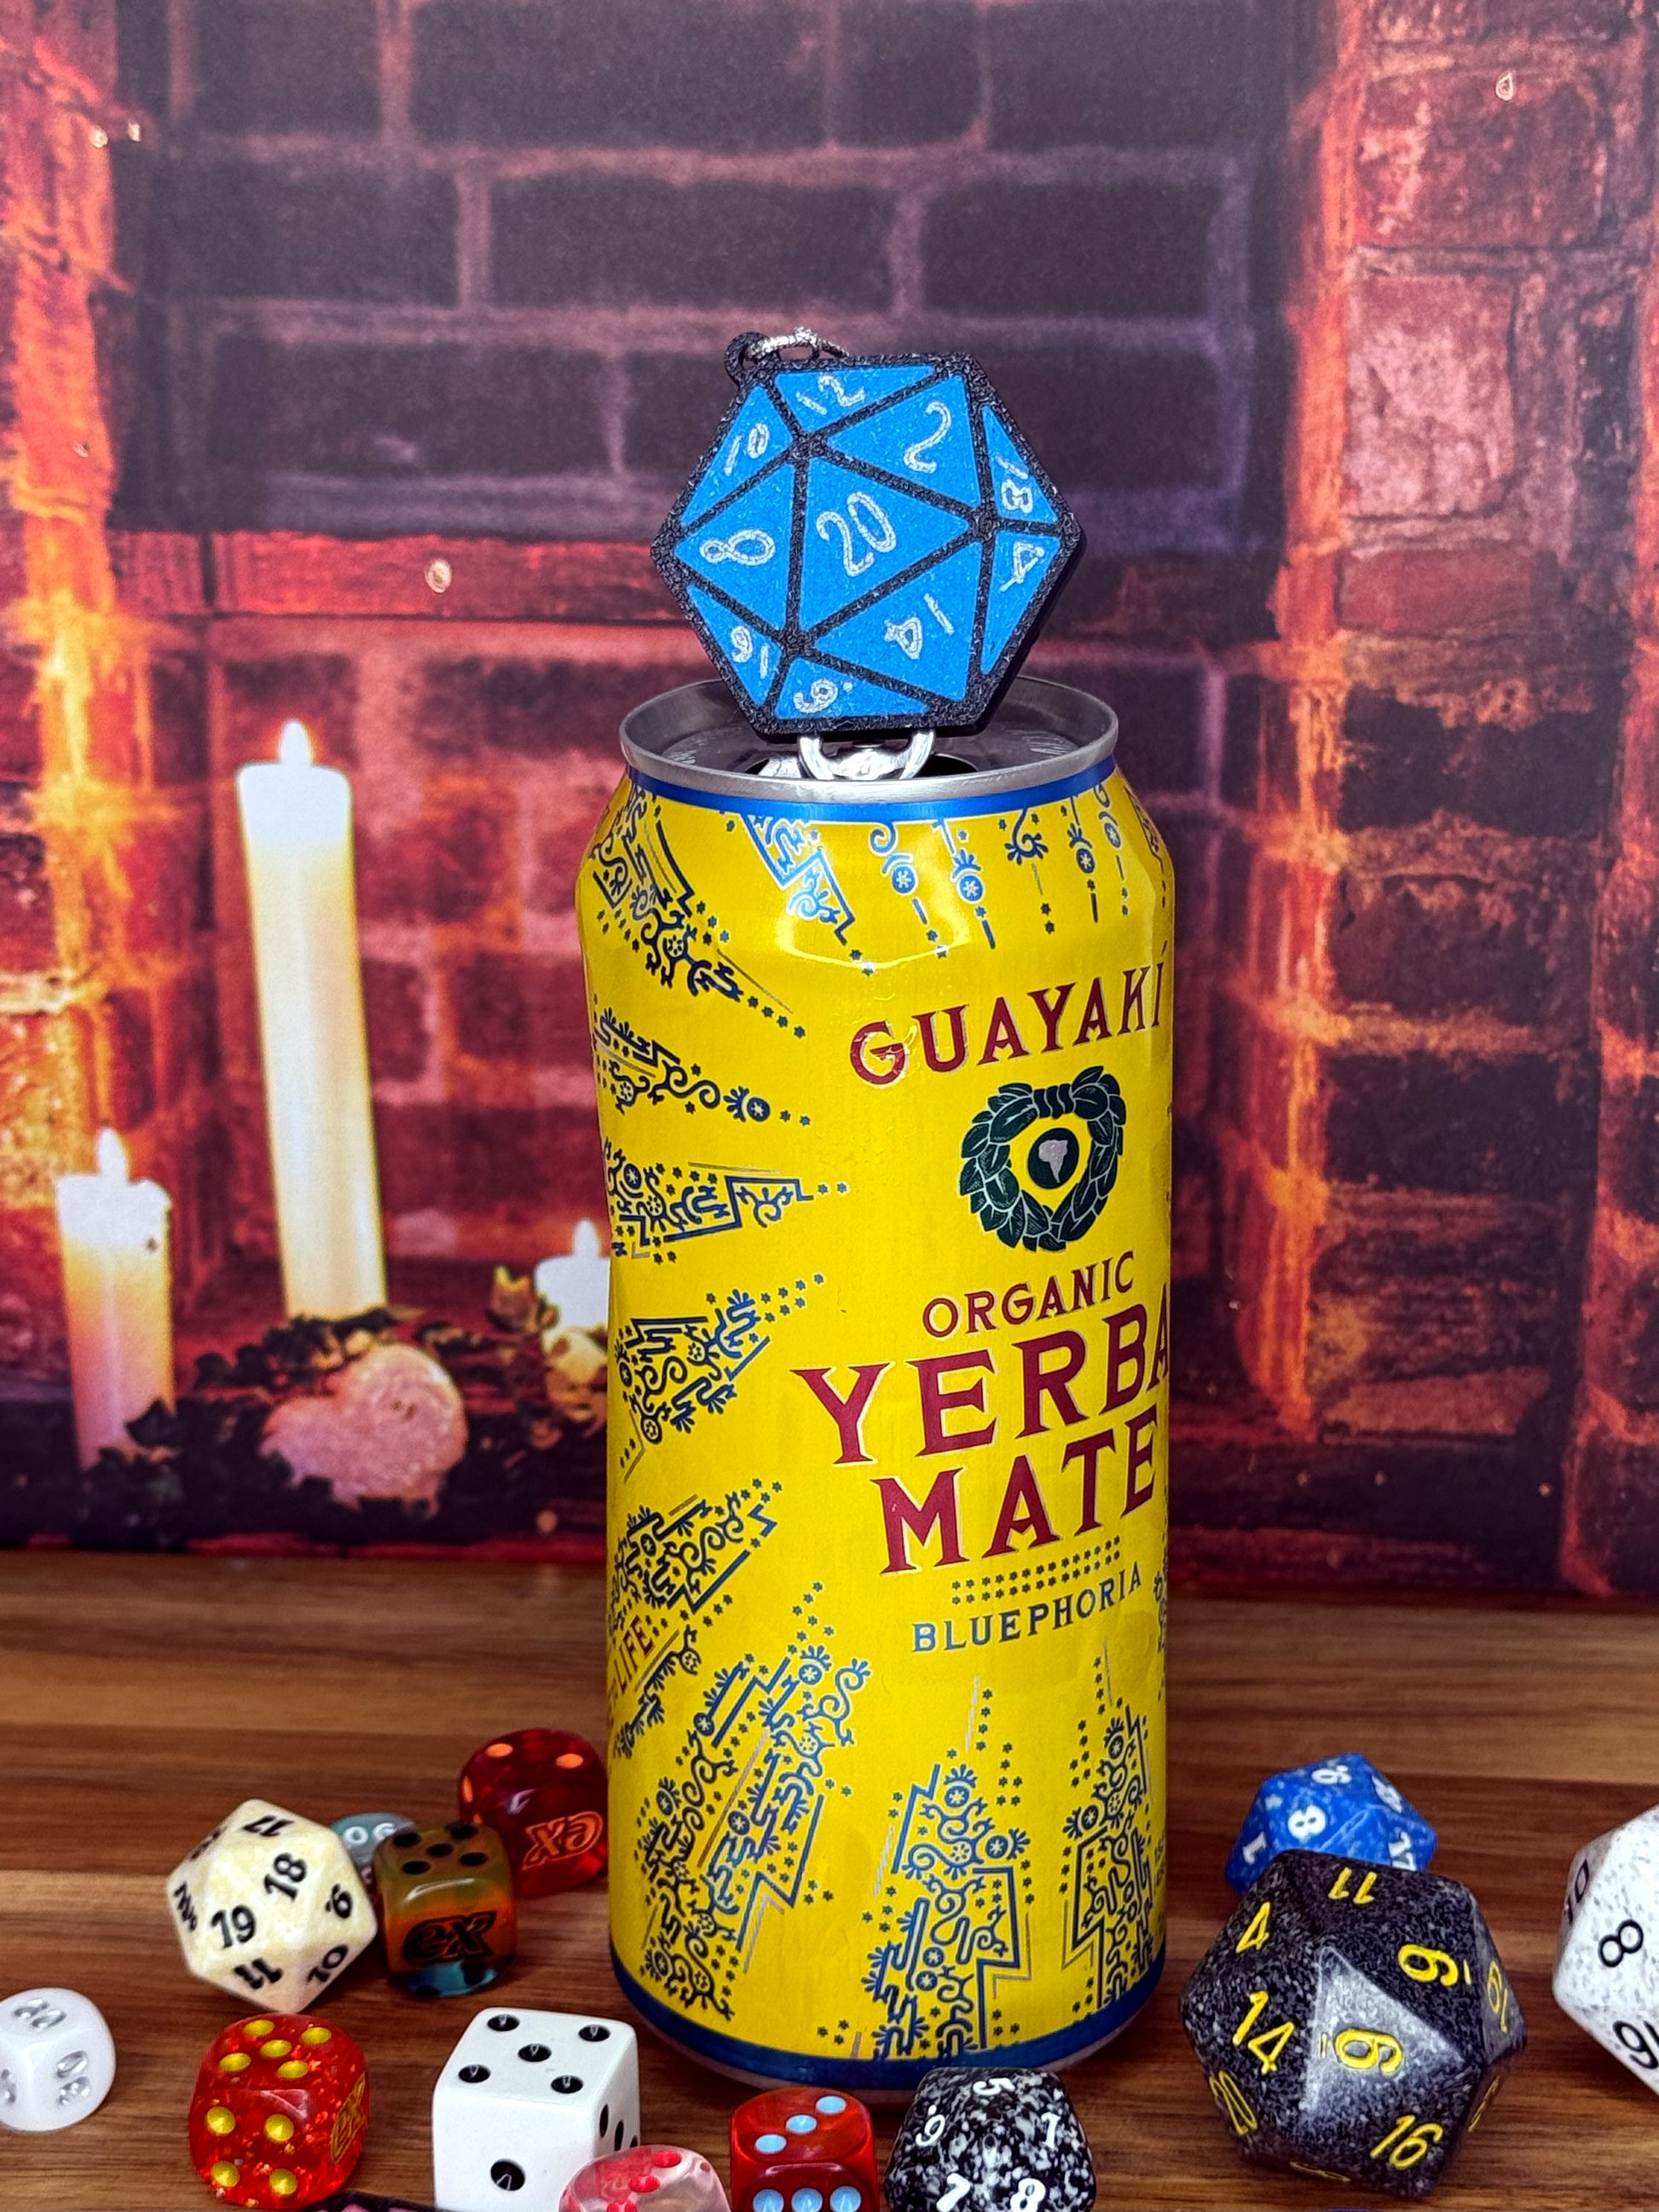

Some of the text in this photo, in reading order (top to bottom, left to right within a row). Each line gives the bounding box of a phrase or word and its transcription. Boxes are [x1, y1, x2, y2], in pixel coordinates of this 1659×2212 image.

[796, 375, 866, 415] 12
[724, 423, 770, 476] 10
[903, 401, 951, 474] 2
[997, 455, 1034, 513] 18
[699, 528, 775, 566] 8
[816, 492, 896, 577] 20
[1000, 541, 1044, 592] 4
[883, 593, 954, 660] 14
[850, 939, 1168, 1086] GUAYAKÍ
[922, 1250, 1134, 1337] ORGANIC
[790, 1281, 1169, 1464] YERBA
[870, 1404, 1158, 1575] MATE
[911, 1562, 1142, 1654] BLUEPHORIA
[615, 1614, 656, 1695] LIFE
[1288, 1805, 1327, 1843] 8
[264, 1852, 309, 1903] 18
[1327, 1866, 1378, 1905] 11
[210, 1903, 257, 1949] 19
[402, 1911, 498, 1964] ex
[1235, 1901, 1271, 1954] 4
[1598, 1919, 1645, 1968] 8
[233, 1957, 285, 1990] 11
[307, 1943, 350, 1984] 10
[1232, 1990, 1296, 2075] 14
[972, 2076, 1016, 2097] 5
[1040, 2111, 1061, 2157] 1
[1369, 2115, 1444, 2170] 16
[936, 2173, 972, 2212] 7
[1009, 2178, 1047, 2212] 8
